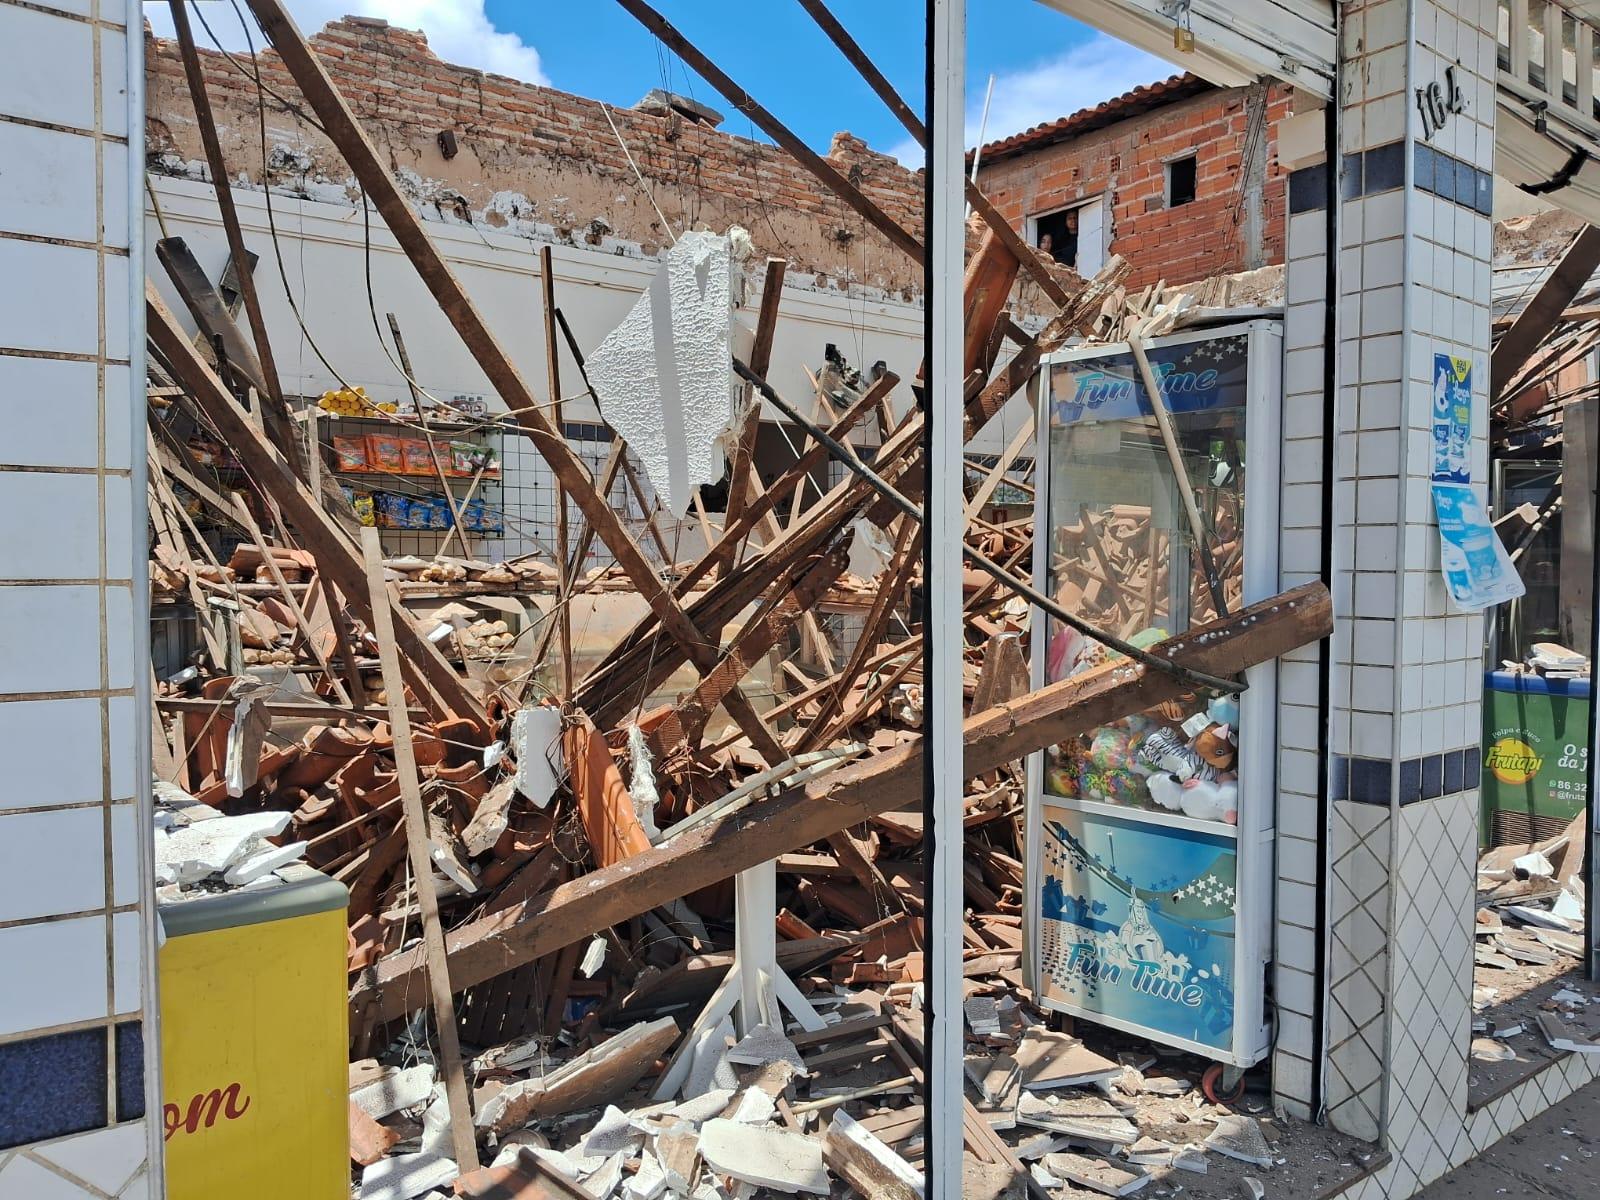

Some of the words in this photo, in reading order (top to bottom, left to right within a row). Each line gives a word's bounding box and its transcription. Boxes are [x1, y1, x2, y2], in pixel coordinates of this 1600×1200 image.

[1415, 66, 1464, 141] 164
[1074, 371, 1132, 404] Fun
[1564, 744, 1577, 756] O
[1557, 756, 1579, 769] da
[1557, 780, 1571, 790] 86
[1065, 942, 1122, 985] Fun
[1127, 959, 1204, 1007] Time
